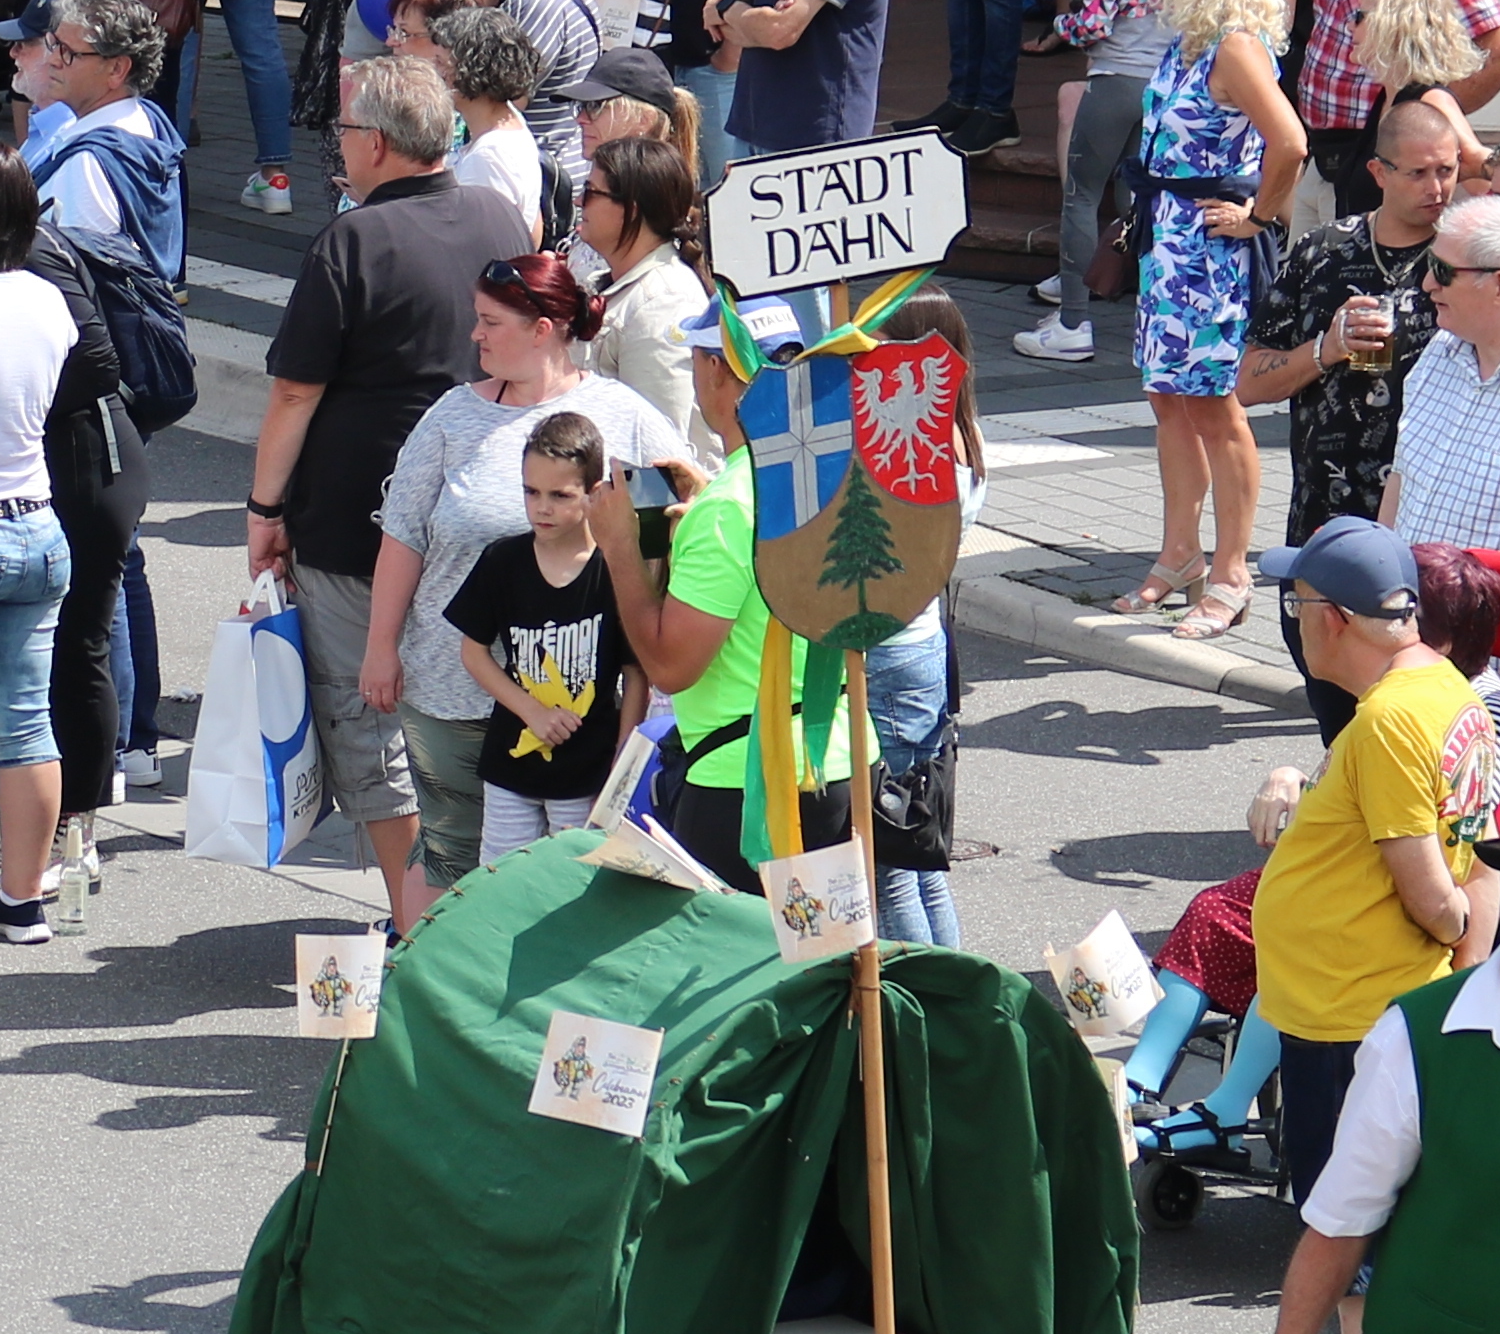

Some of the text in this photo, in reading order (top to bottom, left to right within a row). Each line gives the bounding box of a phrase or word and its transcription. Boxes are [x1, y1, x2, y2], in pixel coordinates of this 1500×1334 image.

[749, 148, 923, 223] STADT
[766, 207, 916, 279] DAHN
[601, 1091, 637, 1110] 2023
